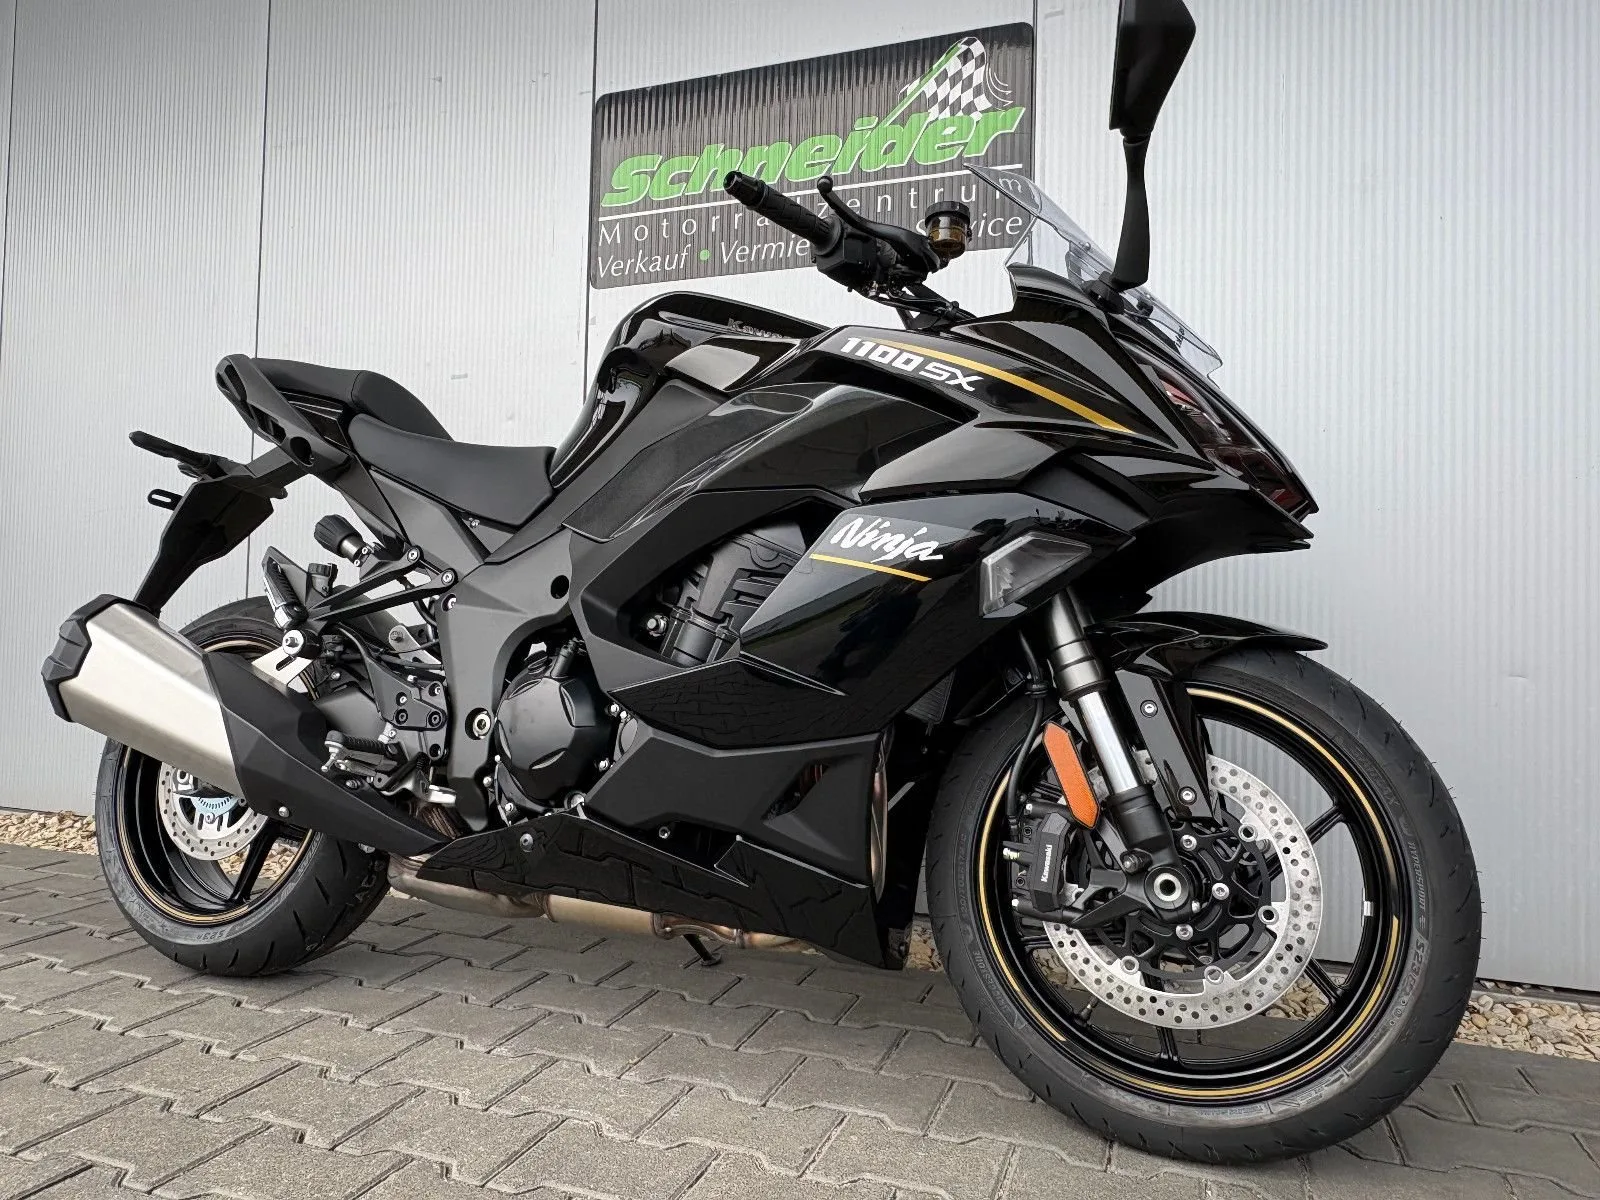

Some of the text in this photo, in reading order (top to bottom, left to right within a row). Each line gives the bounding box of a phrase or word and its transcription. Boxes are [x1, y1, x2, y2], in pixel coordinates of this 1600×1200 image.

[601, 107, 1025, 207] Schneider
[599, 178, 1022, 246] Motorrazentrum
[597, 243, 692, 278] Verkauf
[830, 517, 944, 563] Ninja
[1041, 844, 1053, 882] Kawasaki
